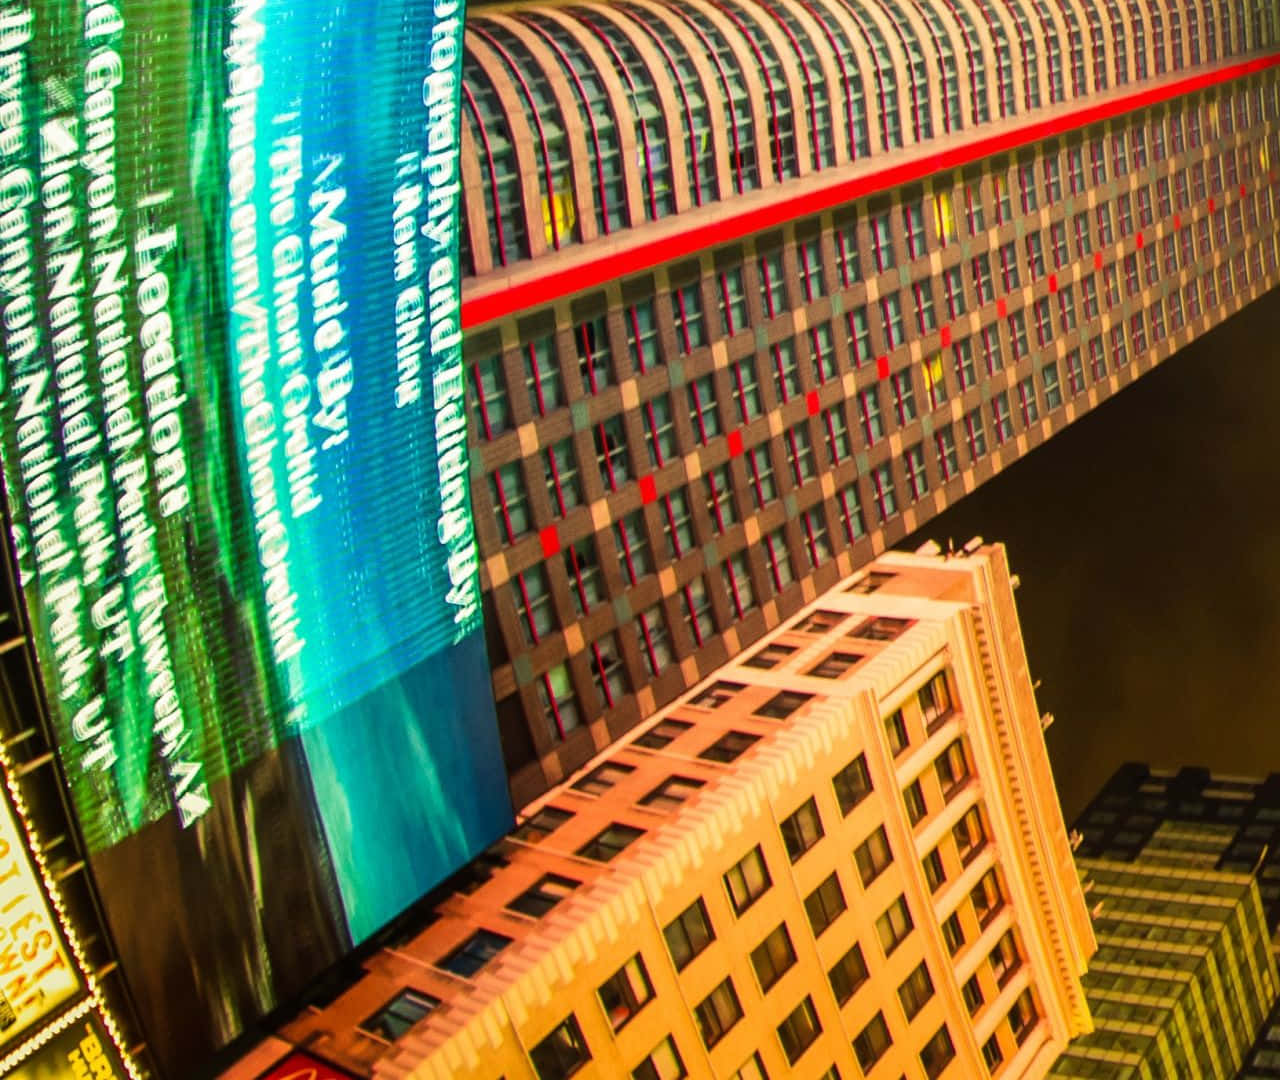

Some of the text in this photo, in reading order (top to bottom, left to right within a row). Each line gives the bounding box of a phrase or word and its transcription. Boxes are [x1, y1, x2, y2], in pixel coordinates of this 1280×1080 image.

[45, 246, 102, 458] National
[89, 584, 135, 663] UT
[427, 256, 462, 356] and
[11, 368, 74, 575] National
[71, 694, 118, 772] UT
